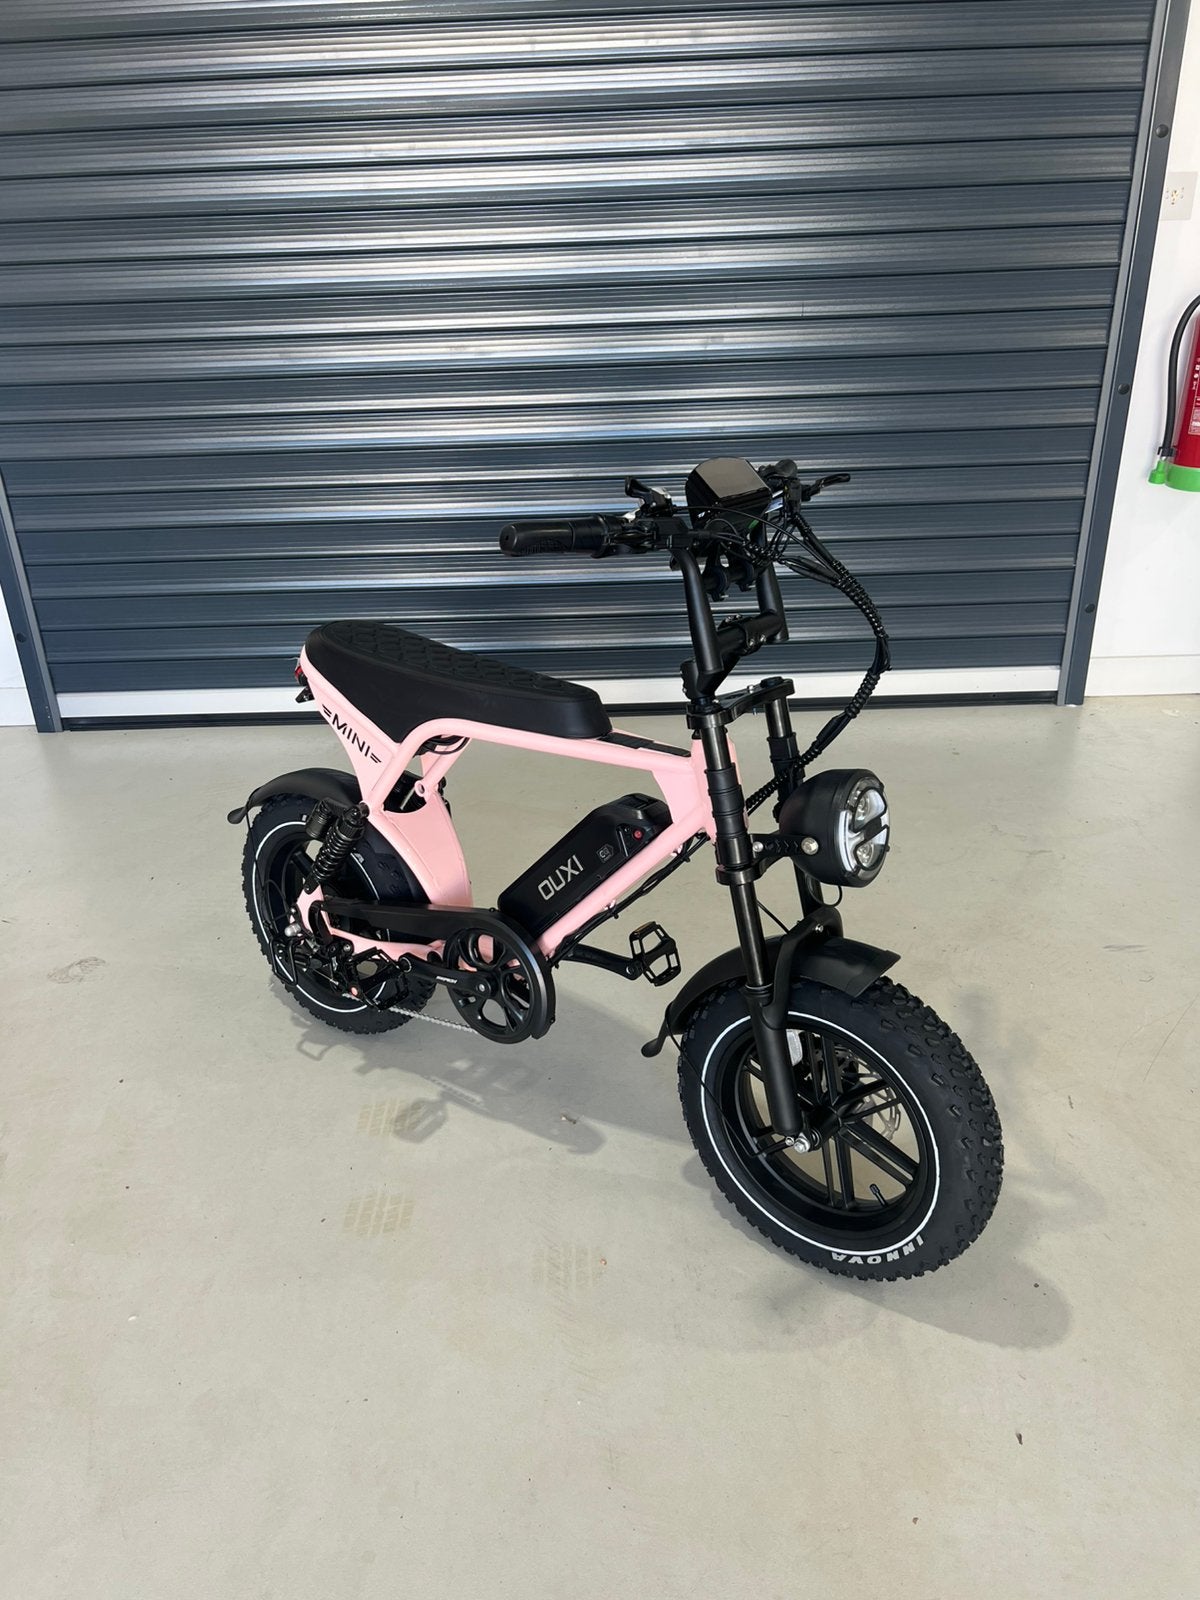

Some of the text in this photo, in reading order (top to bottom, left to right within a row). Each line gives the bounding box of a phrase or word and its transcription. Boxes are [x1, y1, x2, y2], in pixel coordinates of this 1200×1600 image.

[332, 713, 371, 757] MINI
[538, 855, 584, 900] OUXI
[831, 1234, 924, 1265] INNOVA
